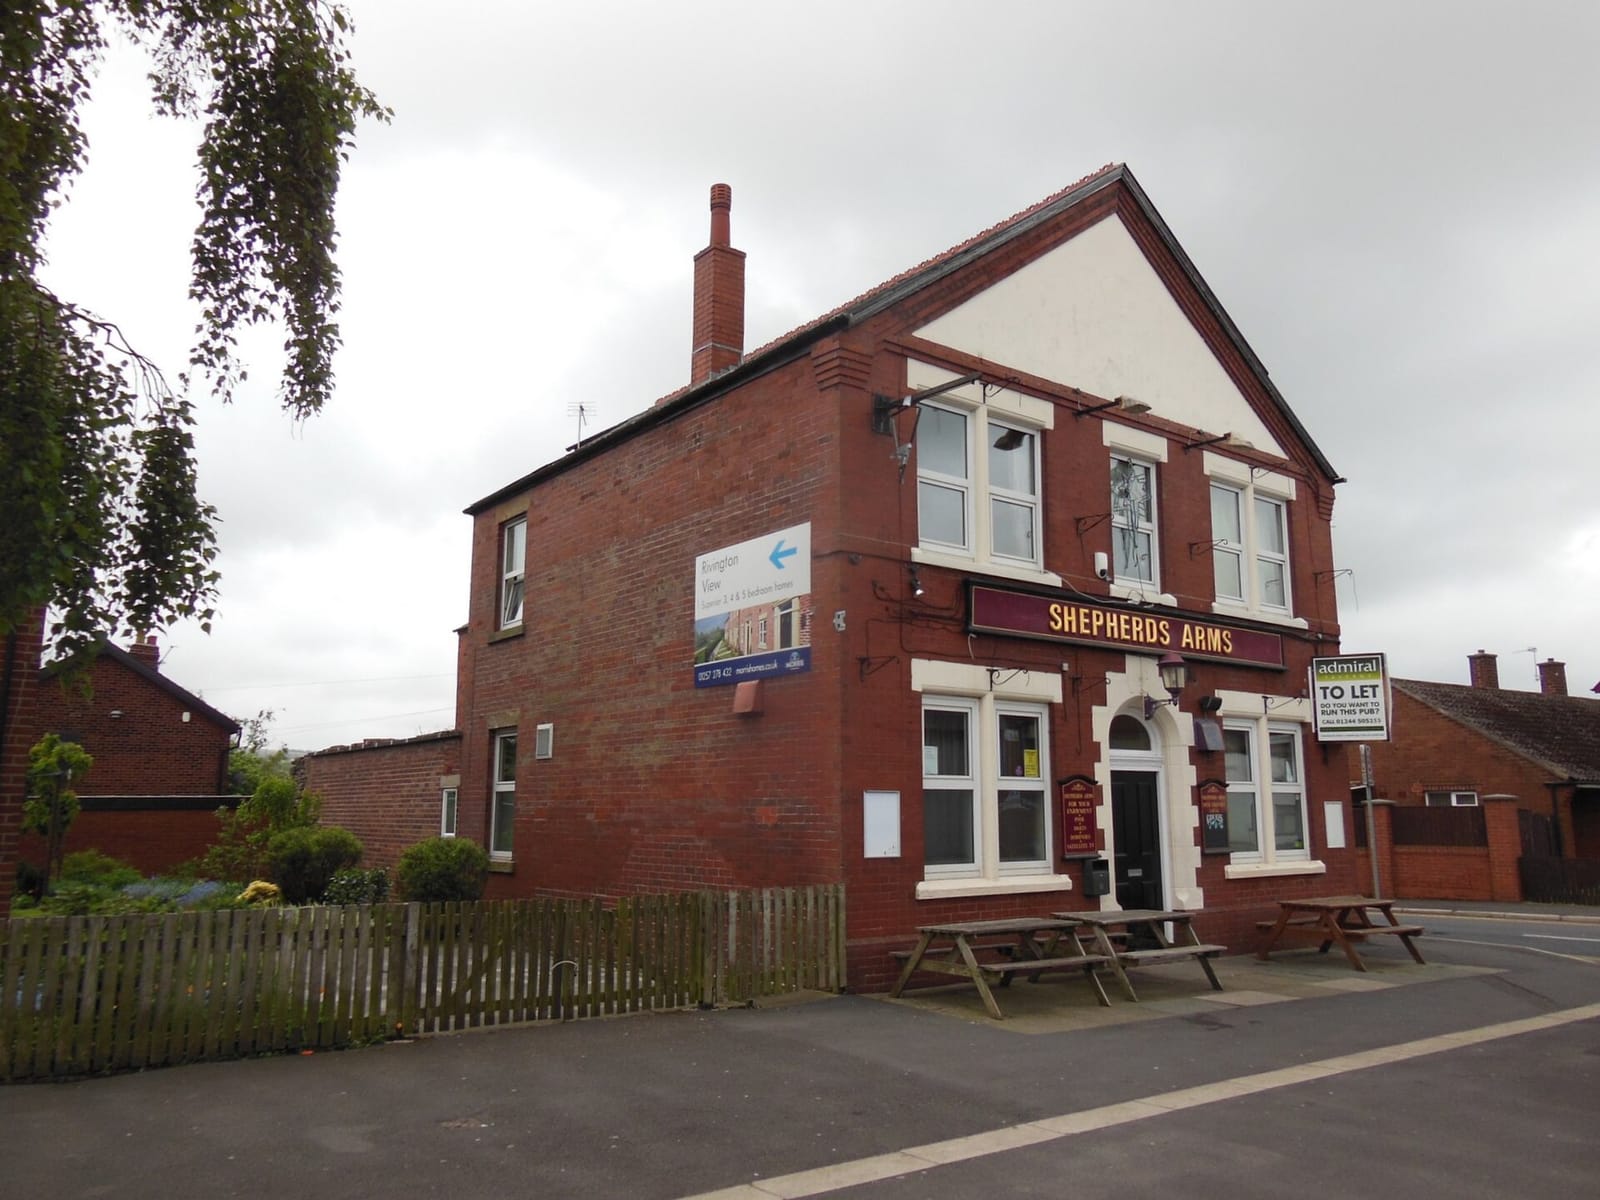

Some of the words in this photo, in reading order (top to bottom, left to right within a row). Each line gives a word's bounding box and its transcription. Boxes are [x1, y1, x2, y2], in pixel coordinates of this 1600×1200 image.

[702, 555, 739, 574] Rivington
[702, 579, 721, 593] View
[742, 589, 746, 600] 5
[747, 585, 773, 598] bedroom
[774, 581, 793, 592] homes
[1049, 603, 1171, 645] SHEPHERDS
[1181, 623, 1233, 653] ARMS
[1319, 660, 1377, 674] admiral
[1320, 686, 1344, 699] TO
[1351, 684, 1379, 699] LET
